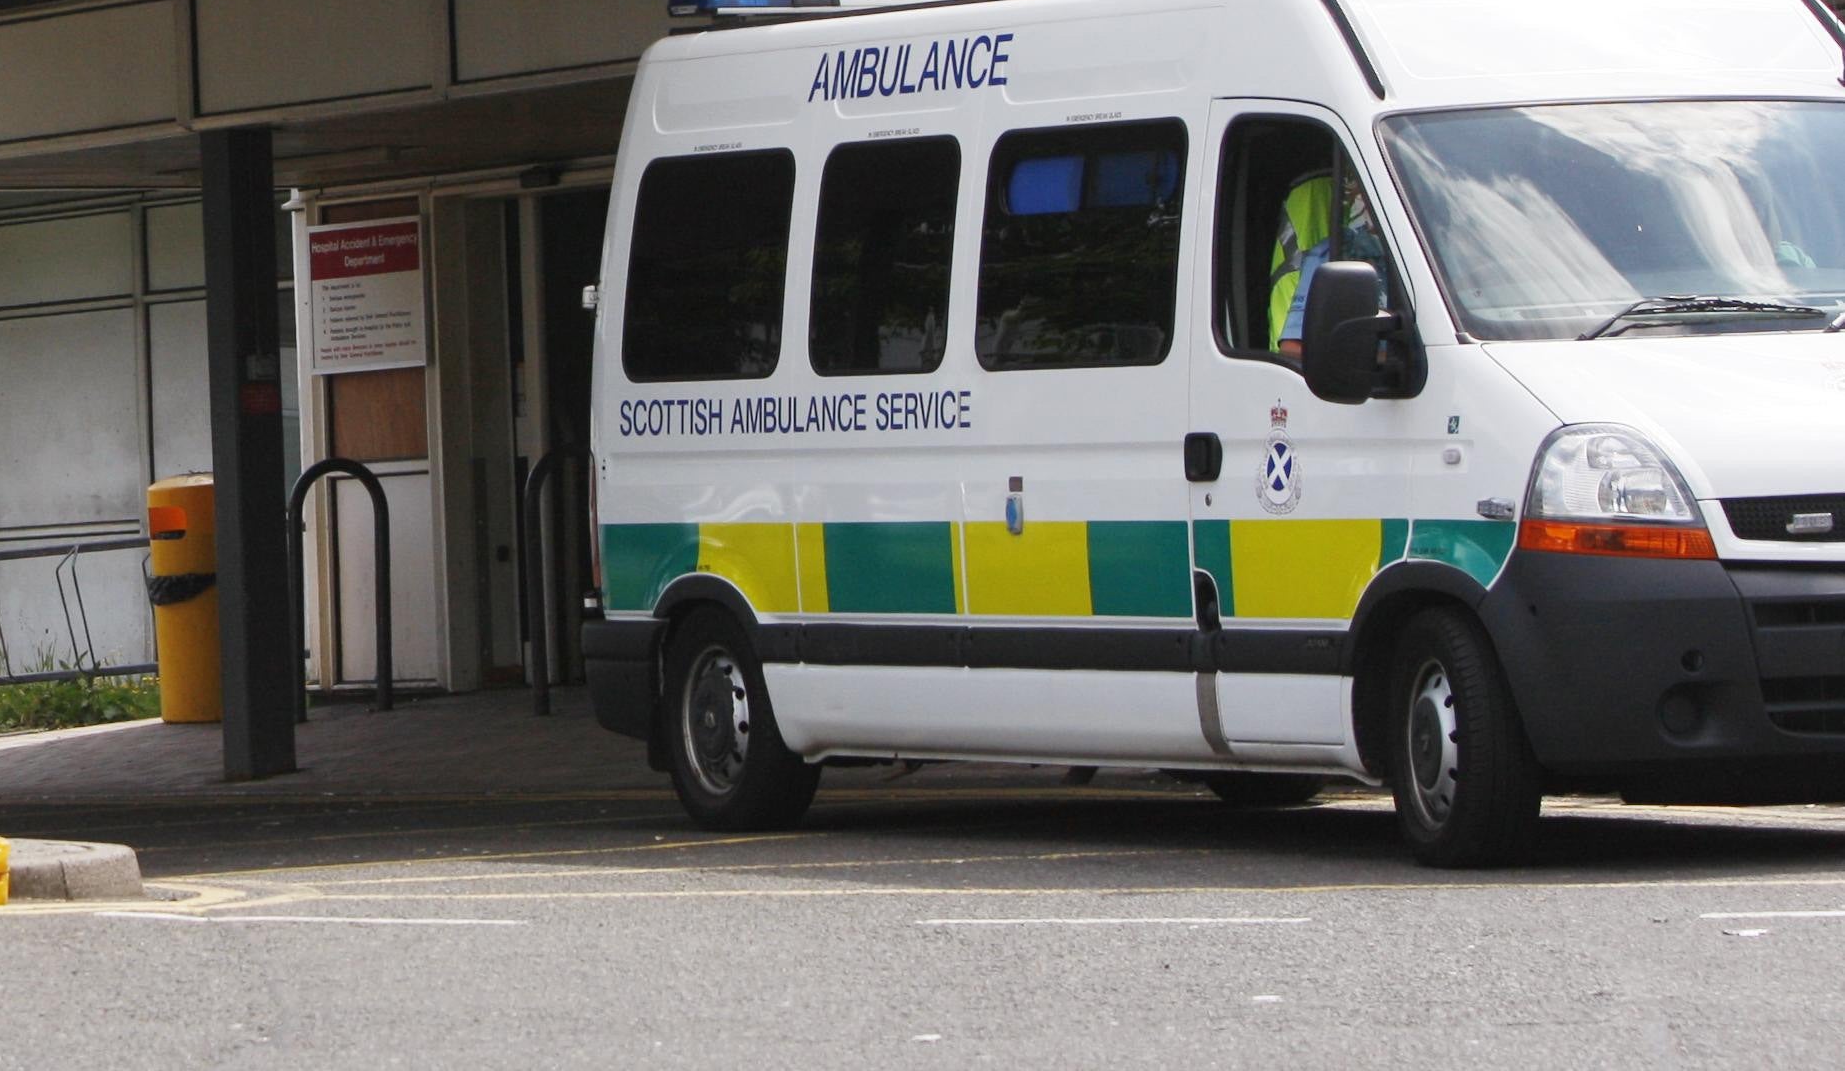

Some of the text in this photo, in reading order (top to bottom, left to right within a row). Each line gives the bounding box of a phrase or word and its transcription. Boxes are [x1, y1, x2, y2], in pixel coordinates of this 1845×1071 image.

[807, 33, 1014, 103] AMBULANCE
[340, 236, 371, 251] Accident
[378, 233, 417, 249] Emergency
[344, 254, 385, 269] Department
[620, 390, 972, 436] SCOTTISH AMBULANCE SERVICE
